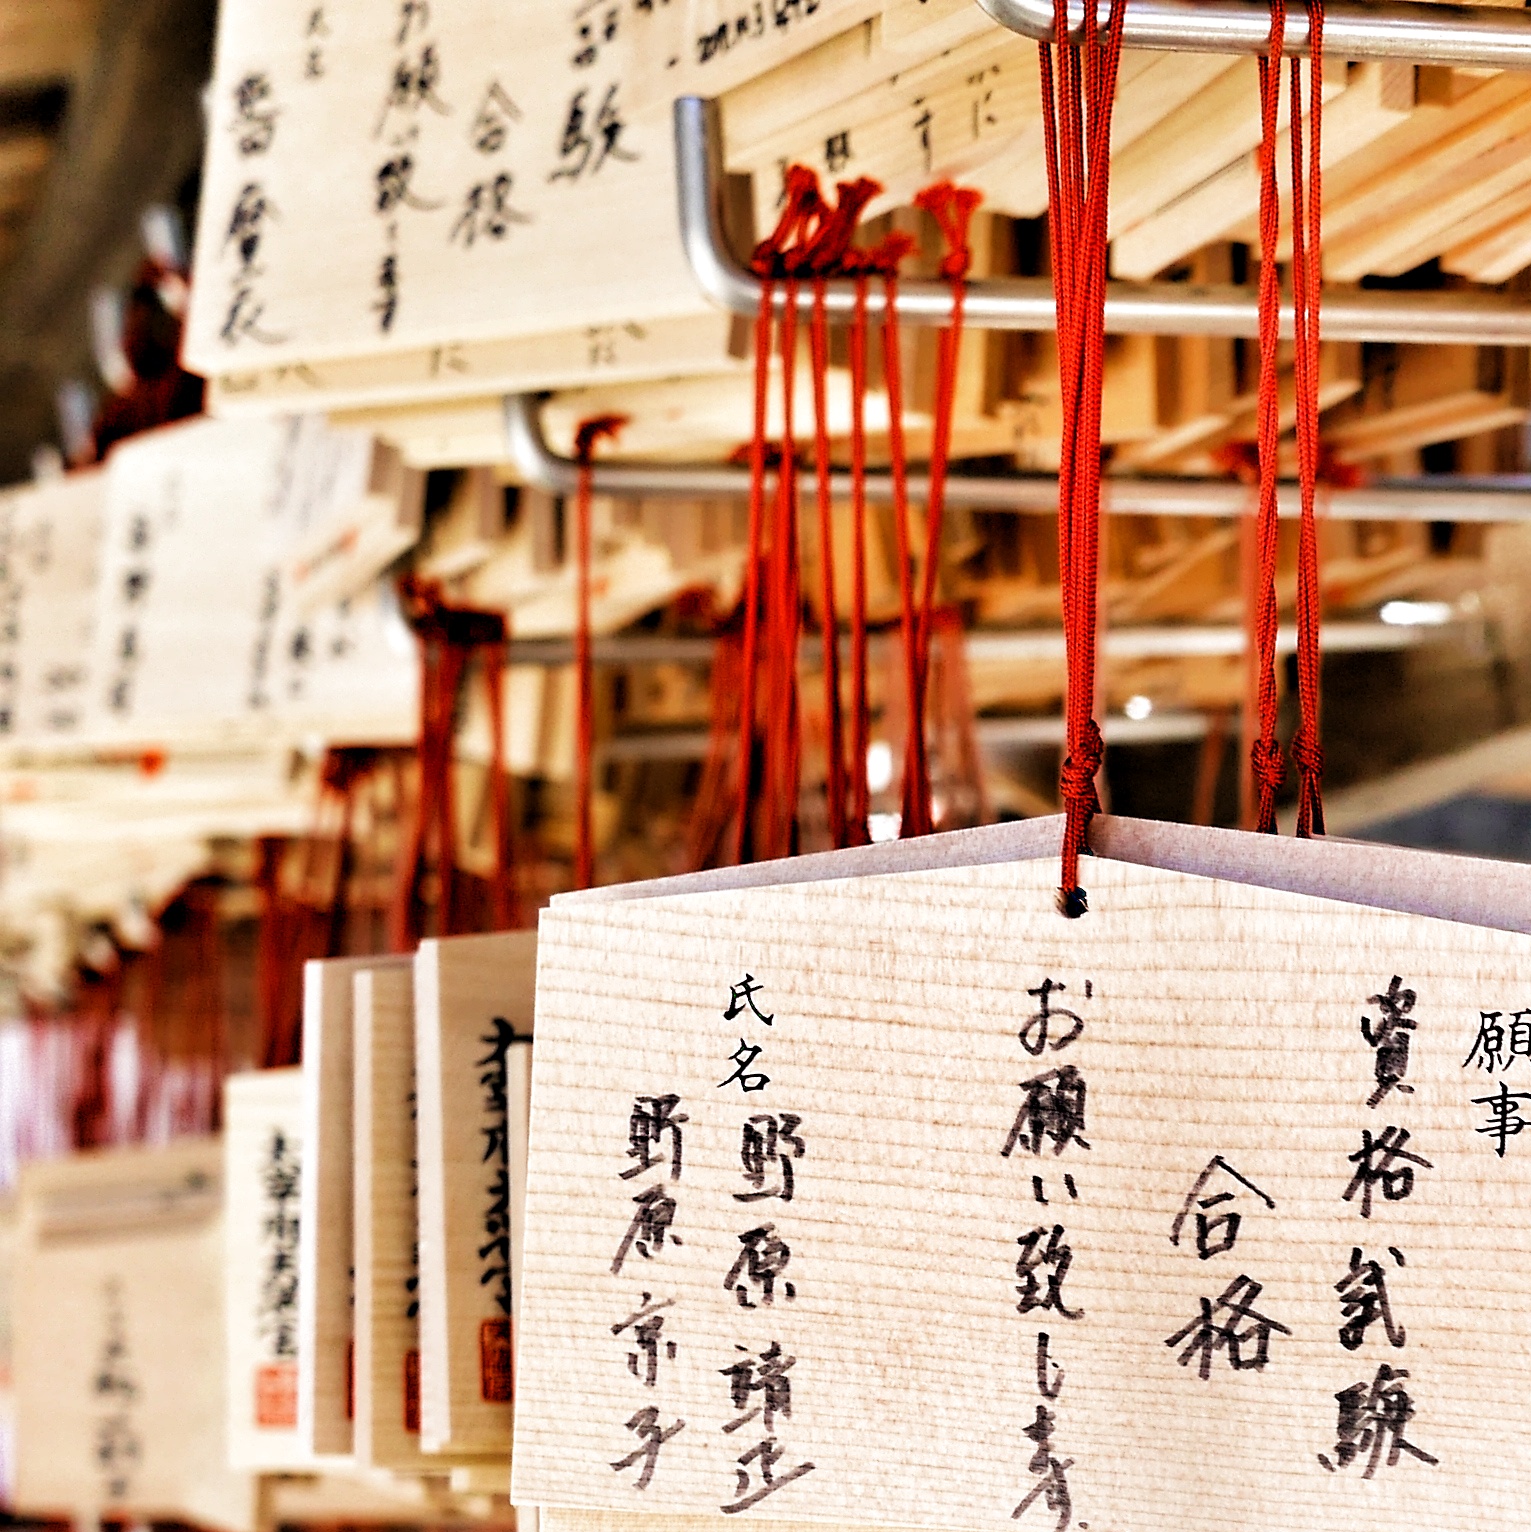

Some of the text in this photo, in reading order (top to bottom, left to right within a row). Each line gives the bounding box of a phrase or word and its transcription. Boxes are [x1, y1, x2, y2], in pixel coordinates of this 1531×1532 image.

[450, 72, 535, 250] 合格
[716, 972, 776, 1093] 氏名
[1164, 1154, 1294, 1382] 合格
